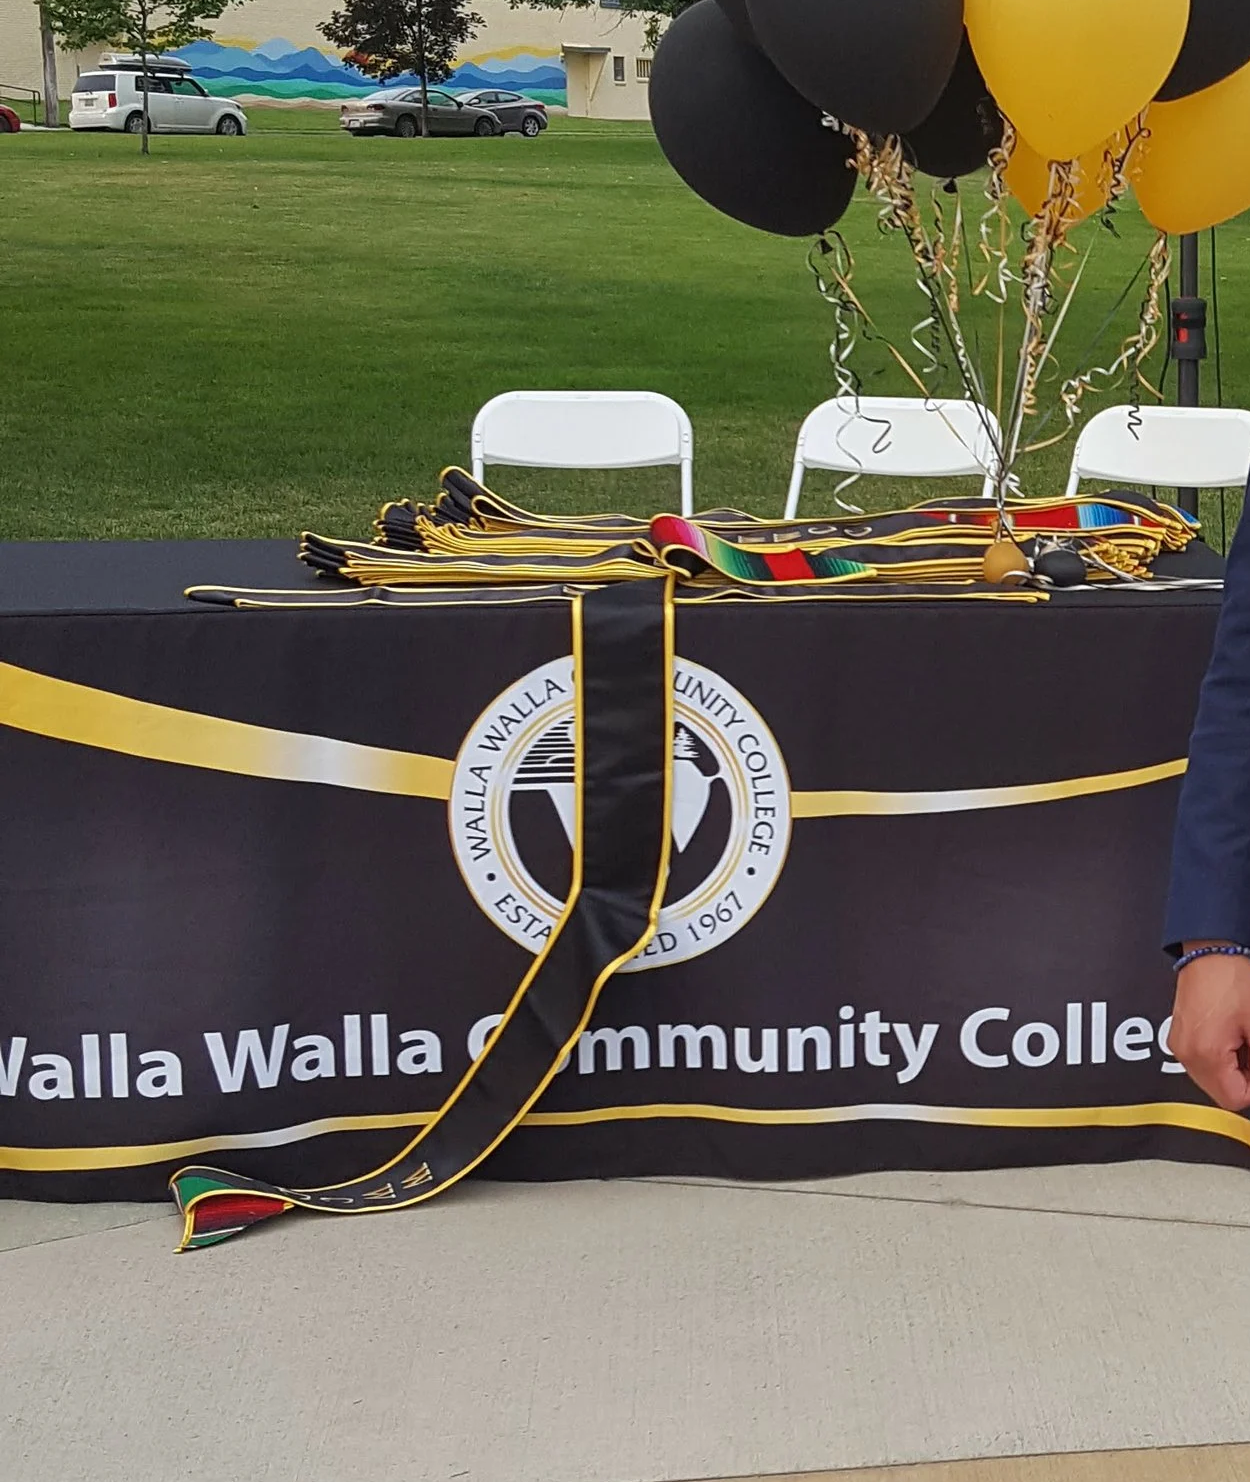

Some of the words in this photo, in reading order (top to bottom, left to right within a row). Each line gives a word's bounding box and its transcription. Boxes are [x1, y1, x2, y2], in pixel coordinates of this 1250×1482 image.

[464, 763, 492, 861] WALLA
[478, 677, 567, 753] WALLA
[737, 733, 776, 855] COLLEGE
[687, 890, 743, 942] 1967
[203, 1013, 443, 1094] Walla
[467, 1005, 940, 1084] Cmmunity
